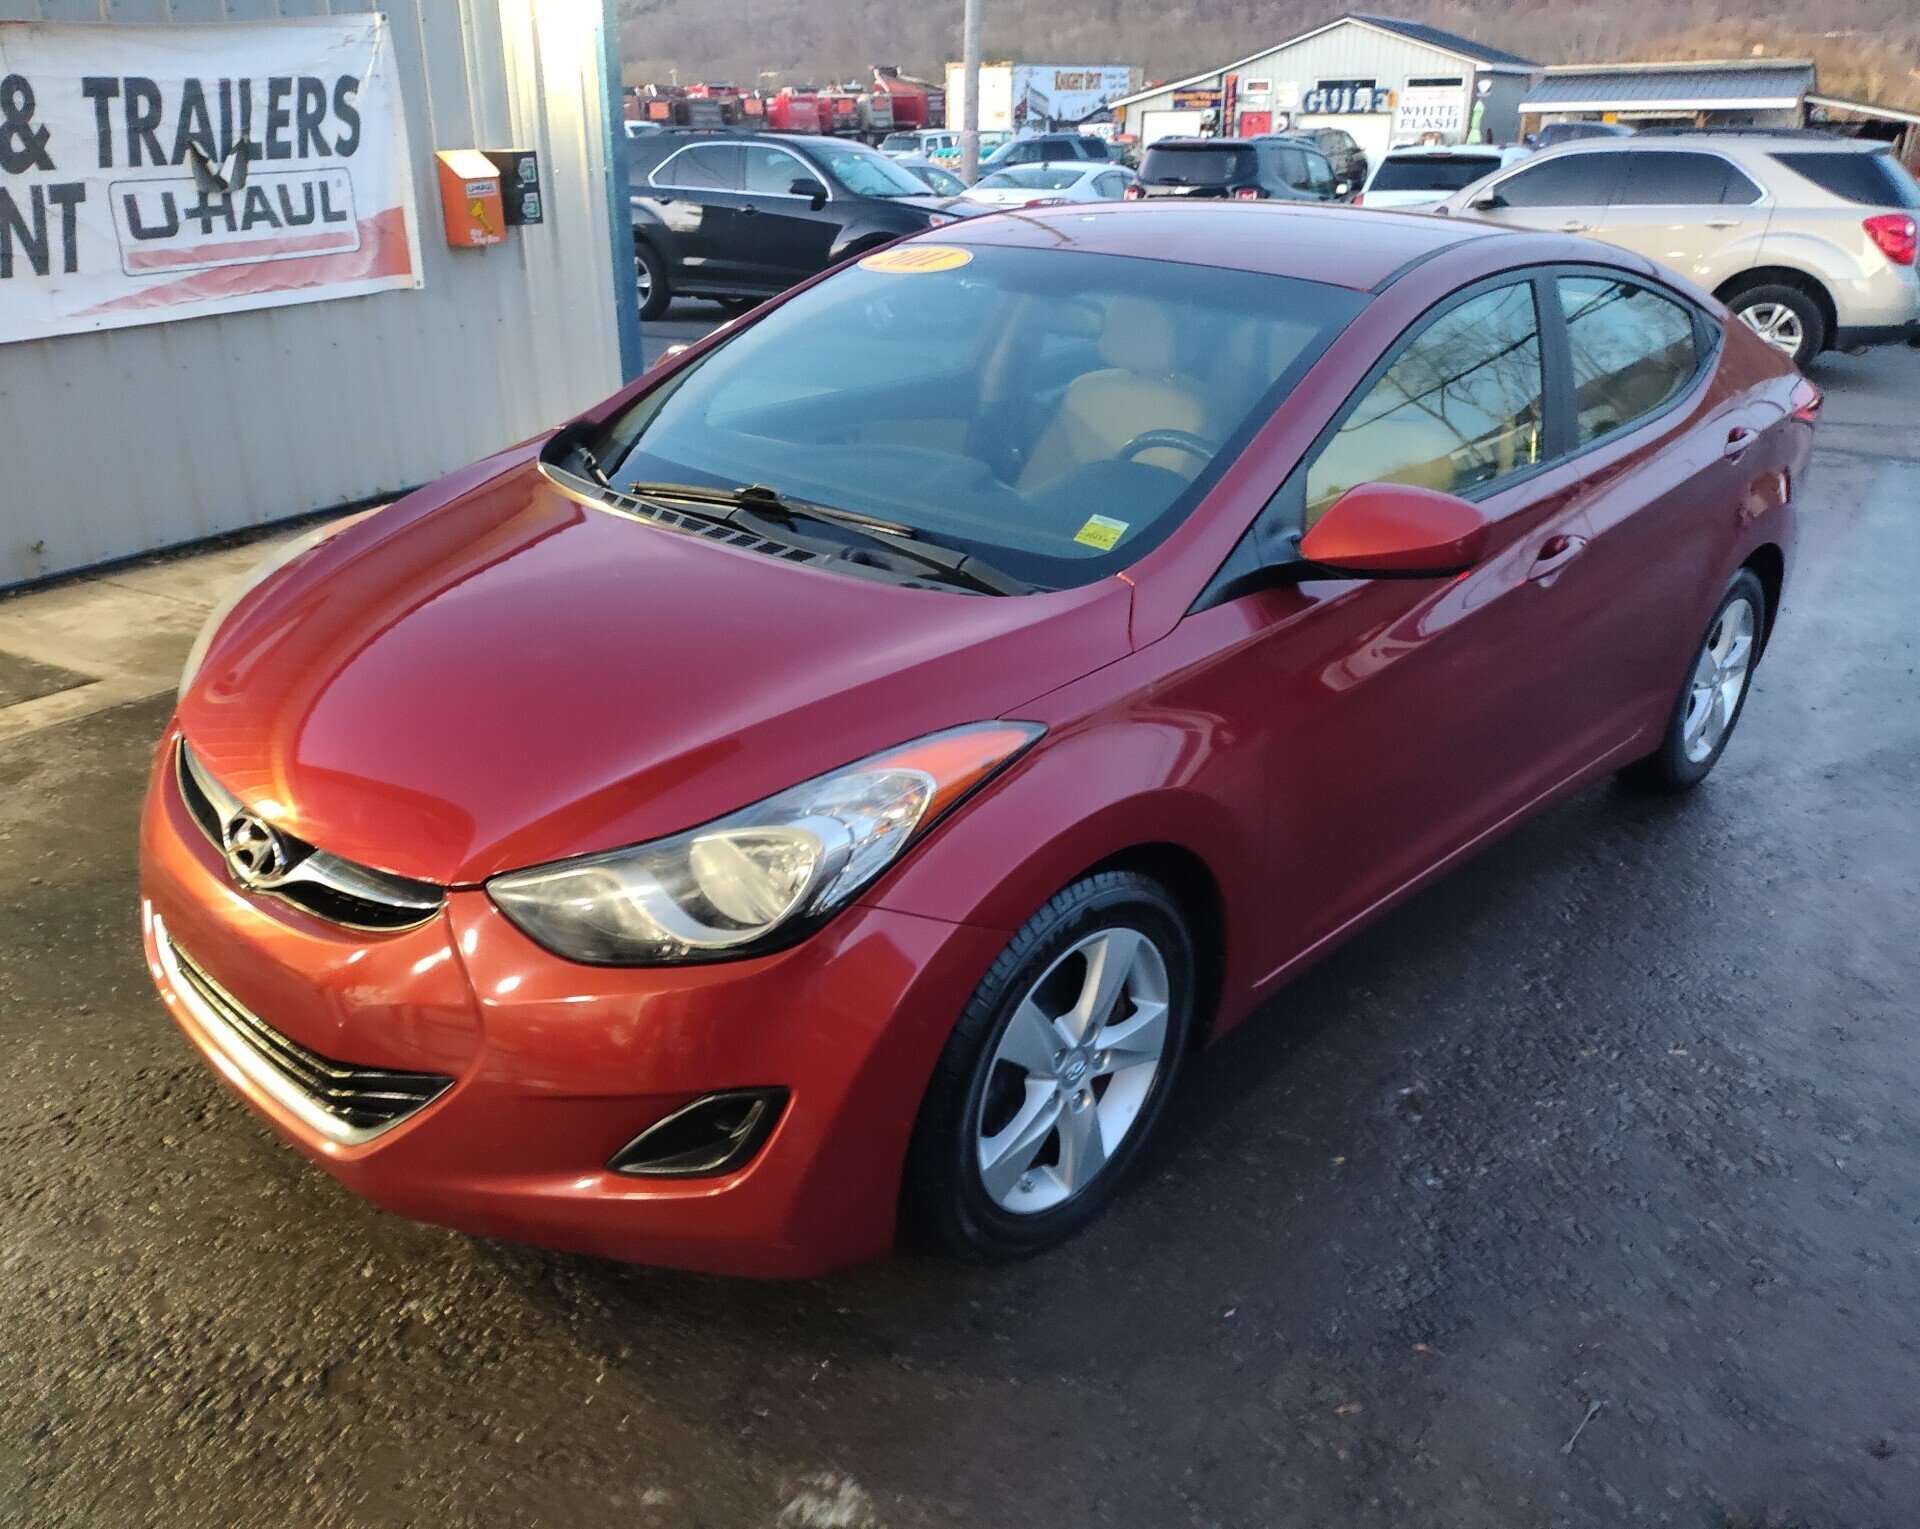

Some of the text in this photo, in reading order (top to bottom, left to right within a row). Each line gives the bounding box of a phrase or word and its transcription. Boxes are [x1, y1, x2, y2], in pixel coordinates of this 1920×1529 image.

[1302, 87, 1390, 114] GULF
[1400, 105, 1459, 116] WHITE
[0, 73, 361, 175] & TRAILERS
[1400, 118, 1458, 129] FLASH
[122, 180, 347, 241] U-HAUL
